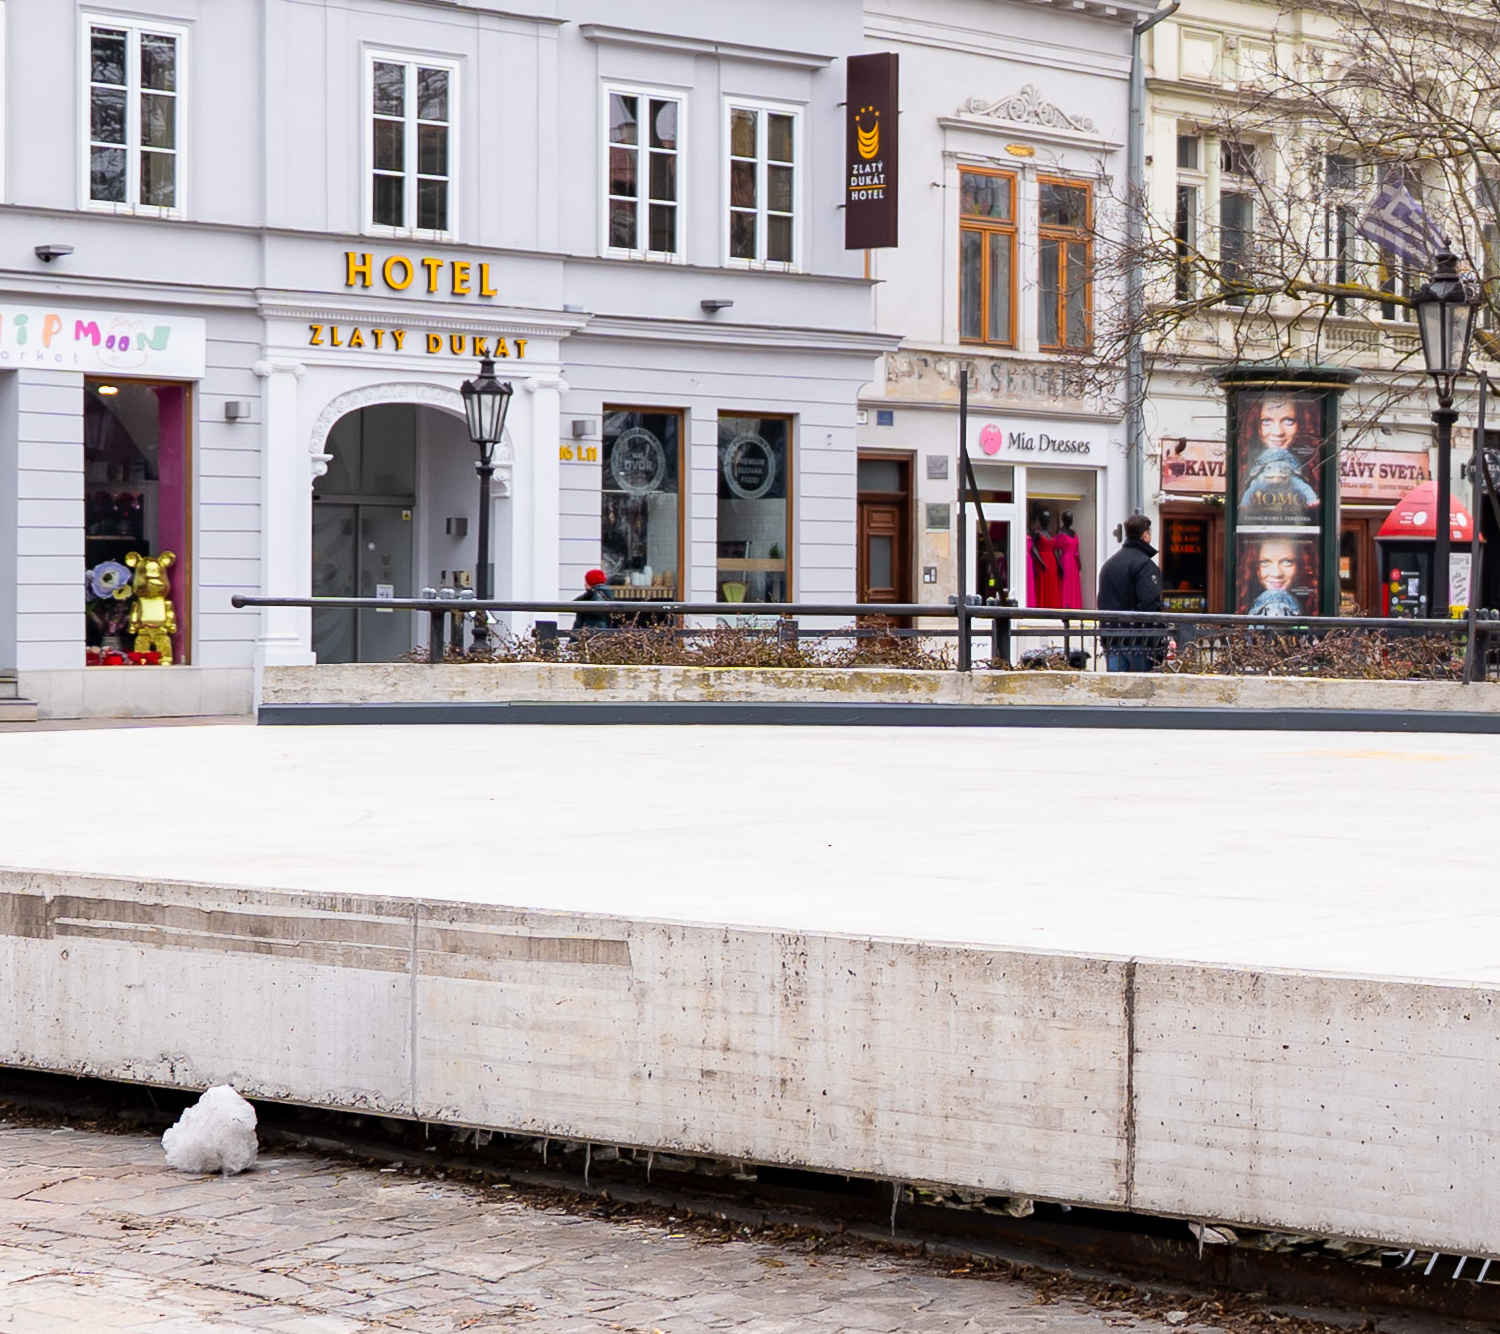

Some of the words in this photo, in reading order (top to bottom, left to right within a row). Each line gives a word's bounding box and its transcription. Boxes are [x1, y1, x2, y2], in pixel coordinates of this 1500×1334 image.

[853, 160, 883, 174] ZLATÝ
[851, 173, 885, 186] DUKÁT
[852, 190, 884, 201] HOTEL
[345, 251, 498, 298] HOTEL
[1008, 431, 1035, 451] Mia
[1039, 434, 1091, 454] Dresses
[1379, 463, 1426, 480] SVETA
